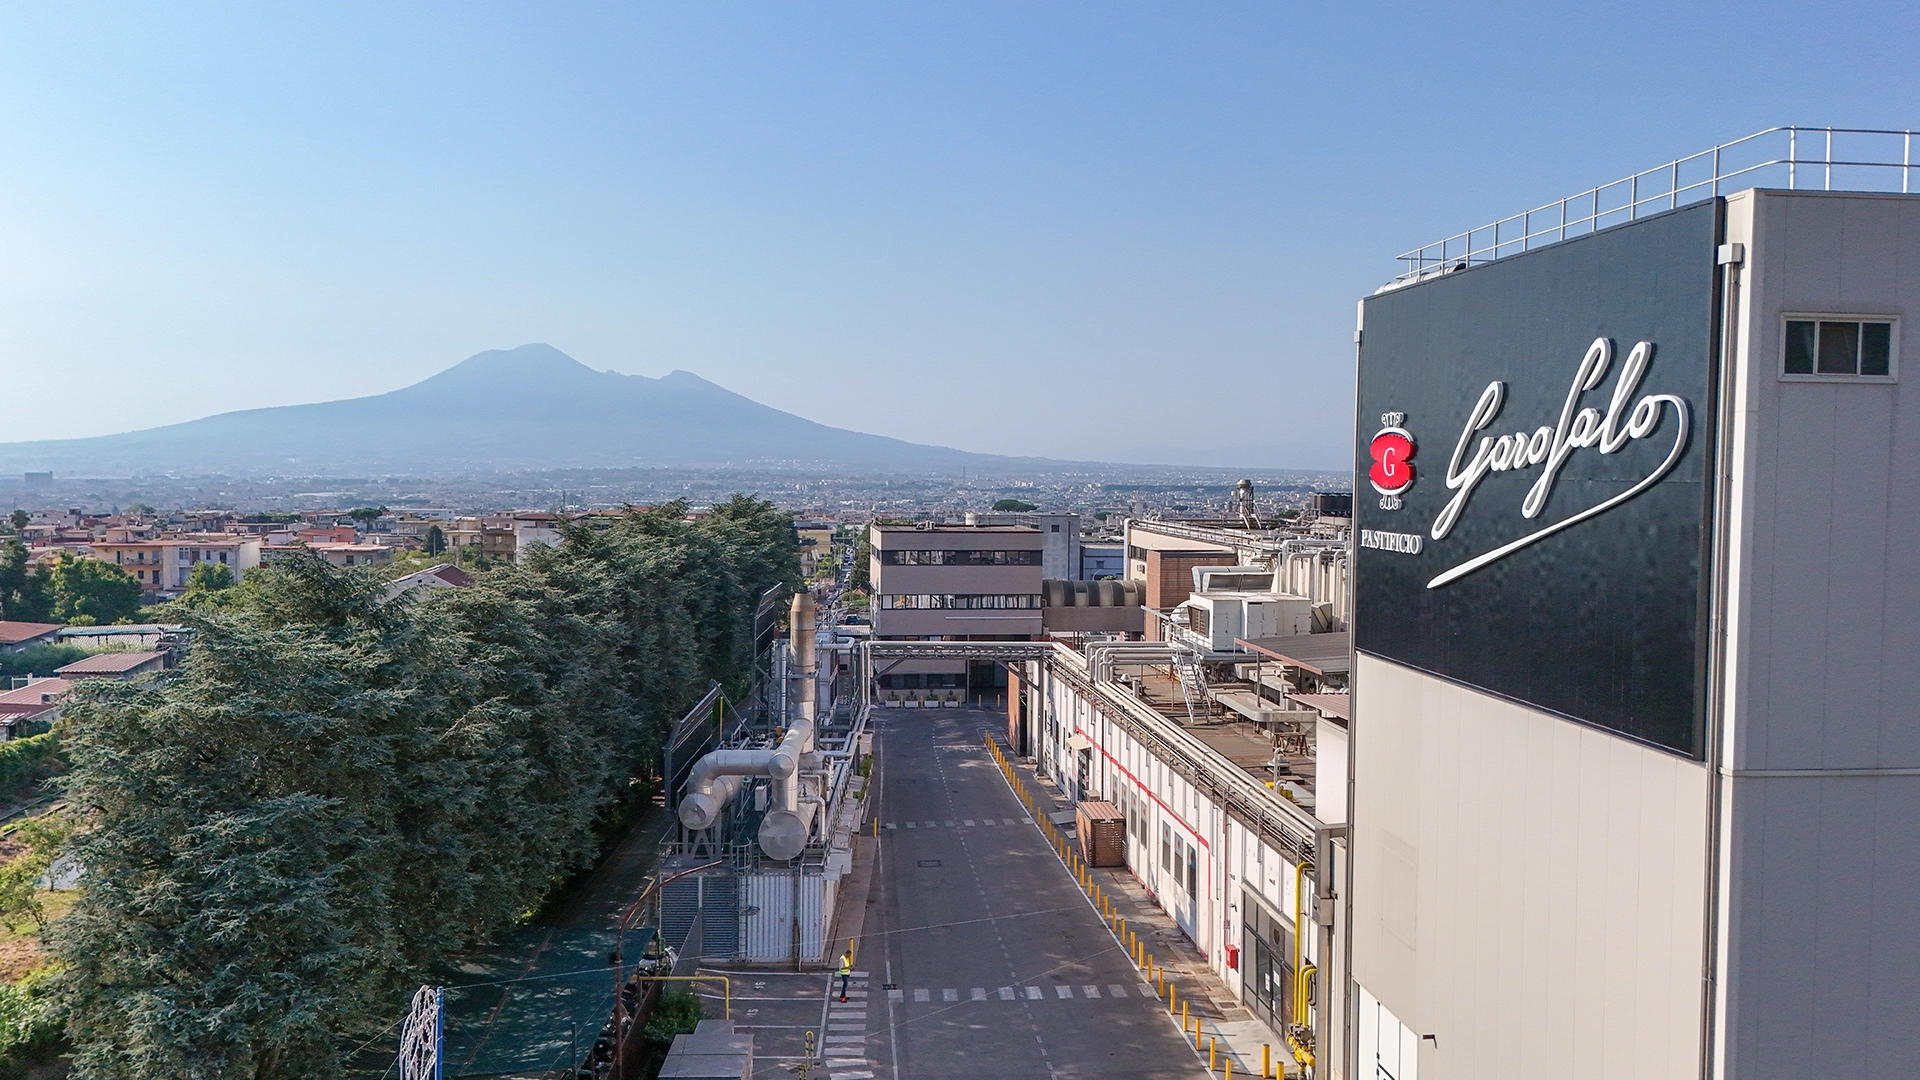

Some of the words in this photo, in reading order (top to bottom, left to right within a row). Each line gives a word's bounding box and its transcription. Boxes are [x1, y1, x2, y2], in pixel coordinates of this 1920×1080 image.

[1430, 337, 1688, 545] Garofalo
[1383, 447, 1396, 477] G
[1361, 529, 1423, 555] PASTIFICIO
